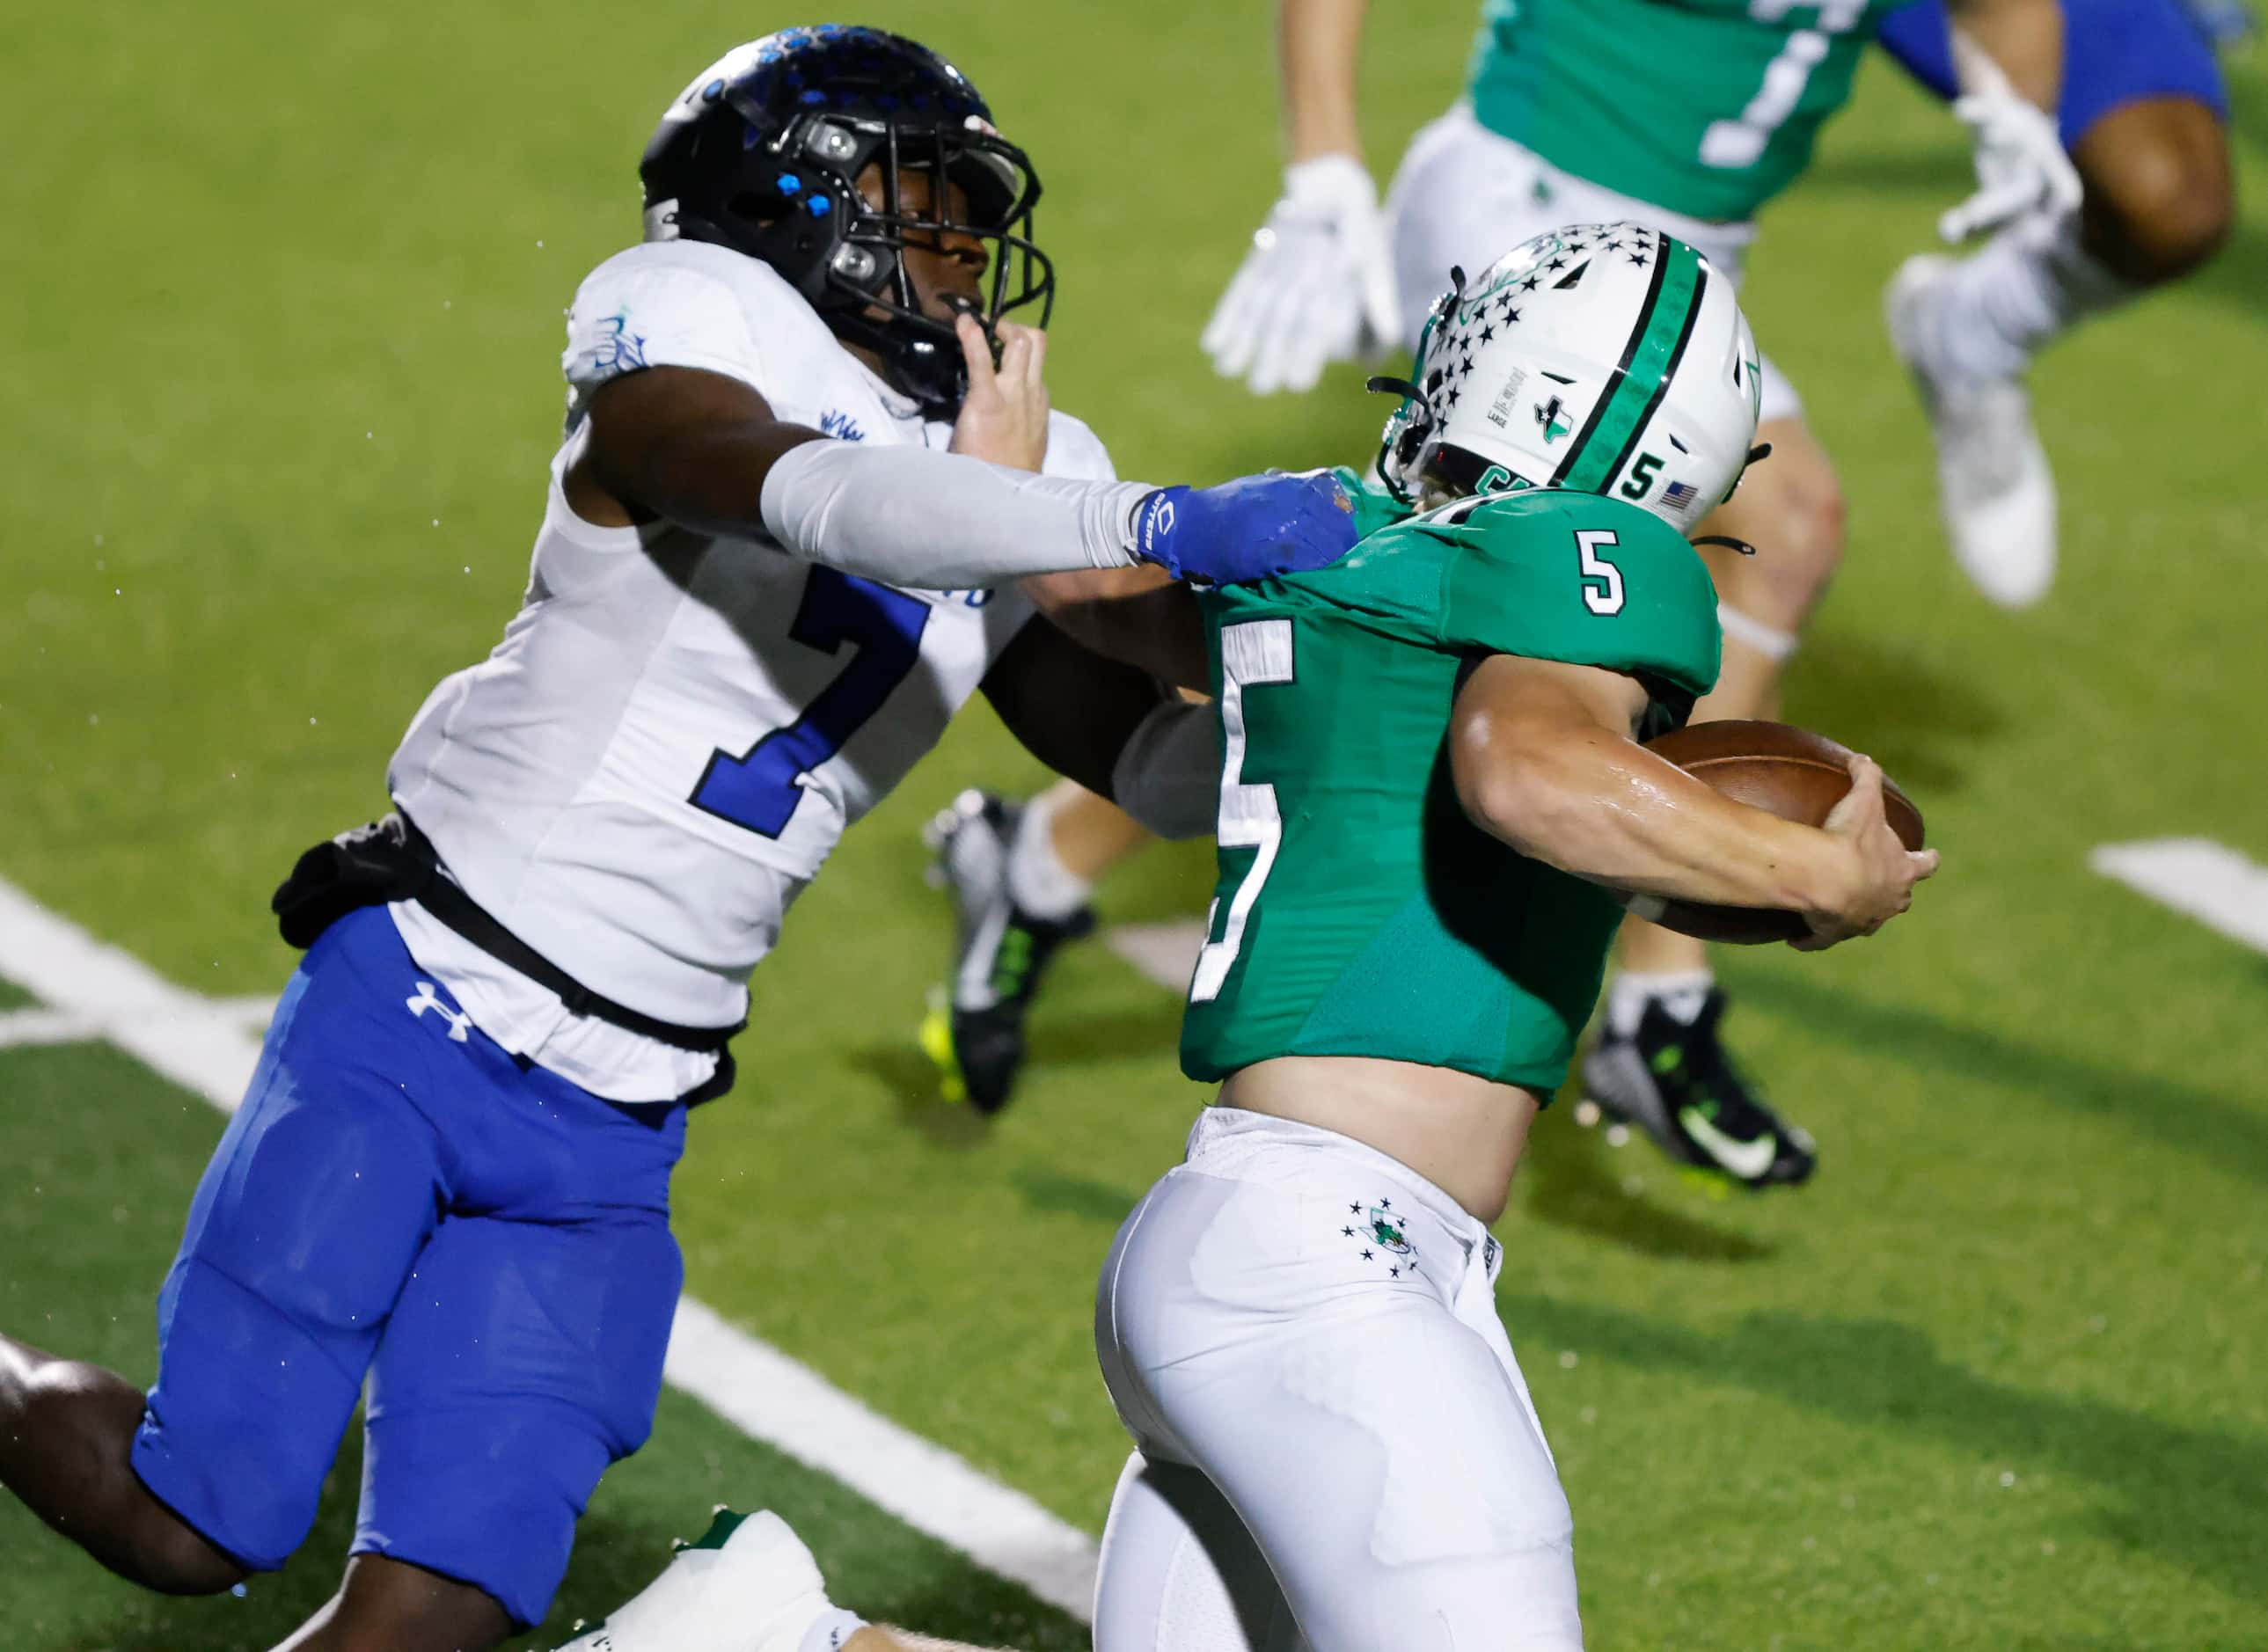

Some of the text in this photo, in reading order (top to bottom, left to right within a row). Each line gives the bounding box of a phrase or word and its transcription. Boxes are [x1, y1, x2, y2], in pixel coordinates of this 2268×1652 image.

[1700, 0, 1867, 168] 7
[1621, 451, 1665, 500] 5
[1573, 530, 1627, 618] 5
[688, 563, 932, 840] 7
[1190, 617, 1294, 1003] 5
